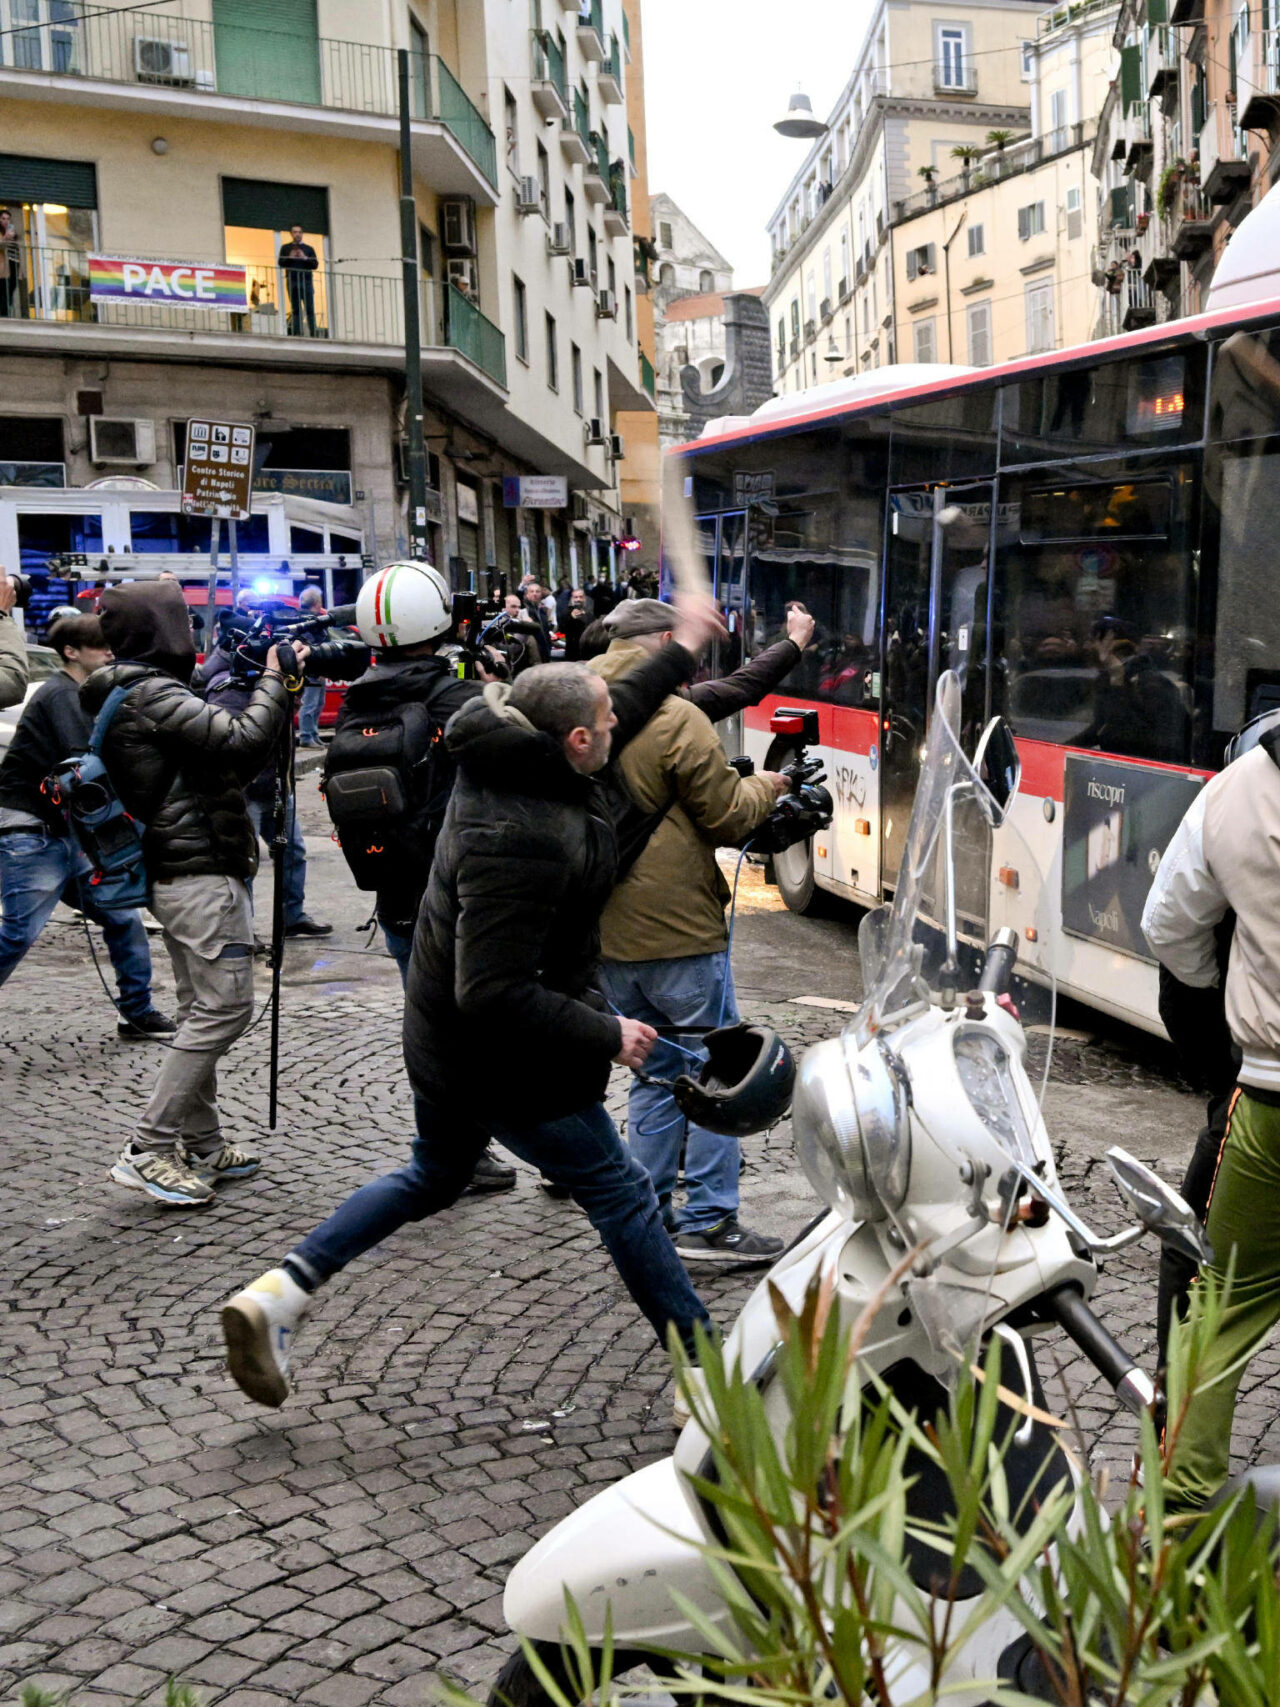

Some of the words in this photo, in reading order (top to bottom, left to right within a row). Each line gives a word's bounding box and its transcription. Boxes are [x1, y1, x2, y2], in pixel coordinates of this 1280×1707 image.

[122, 264, 216, 299] PACE
[191, 465, 217, 476] Centro
[218, 467, 245, 479] Storico
[200, 478, 208, 486] di
[210, 478, 236, 489] Napoli
[1087, 776, 1125, 807] riscopri
